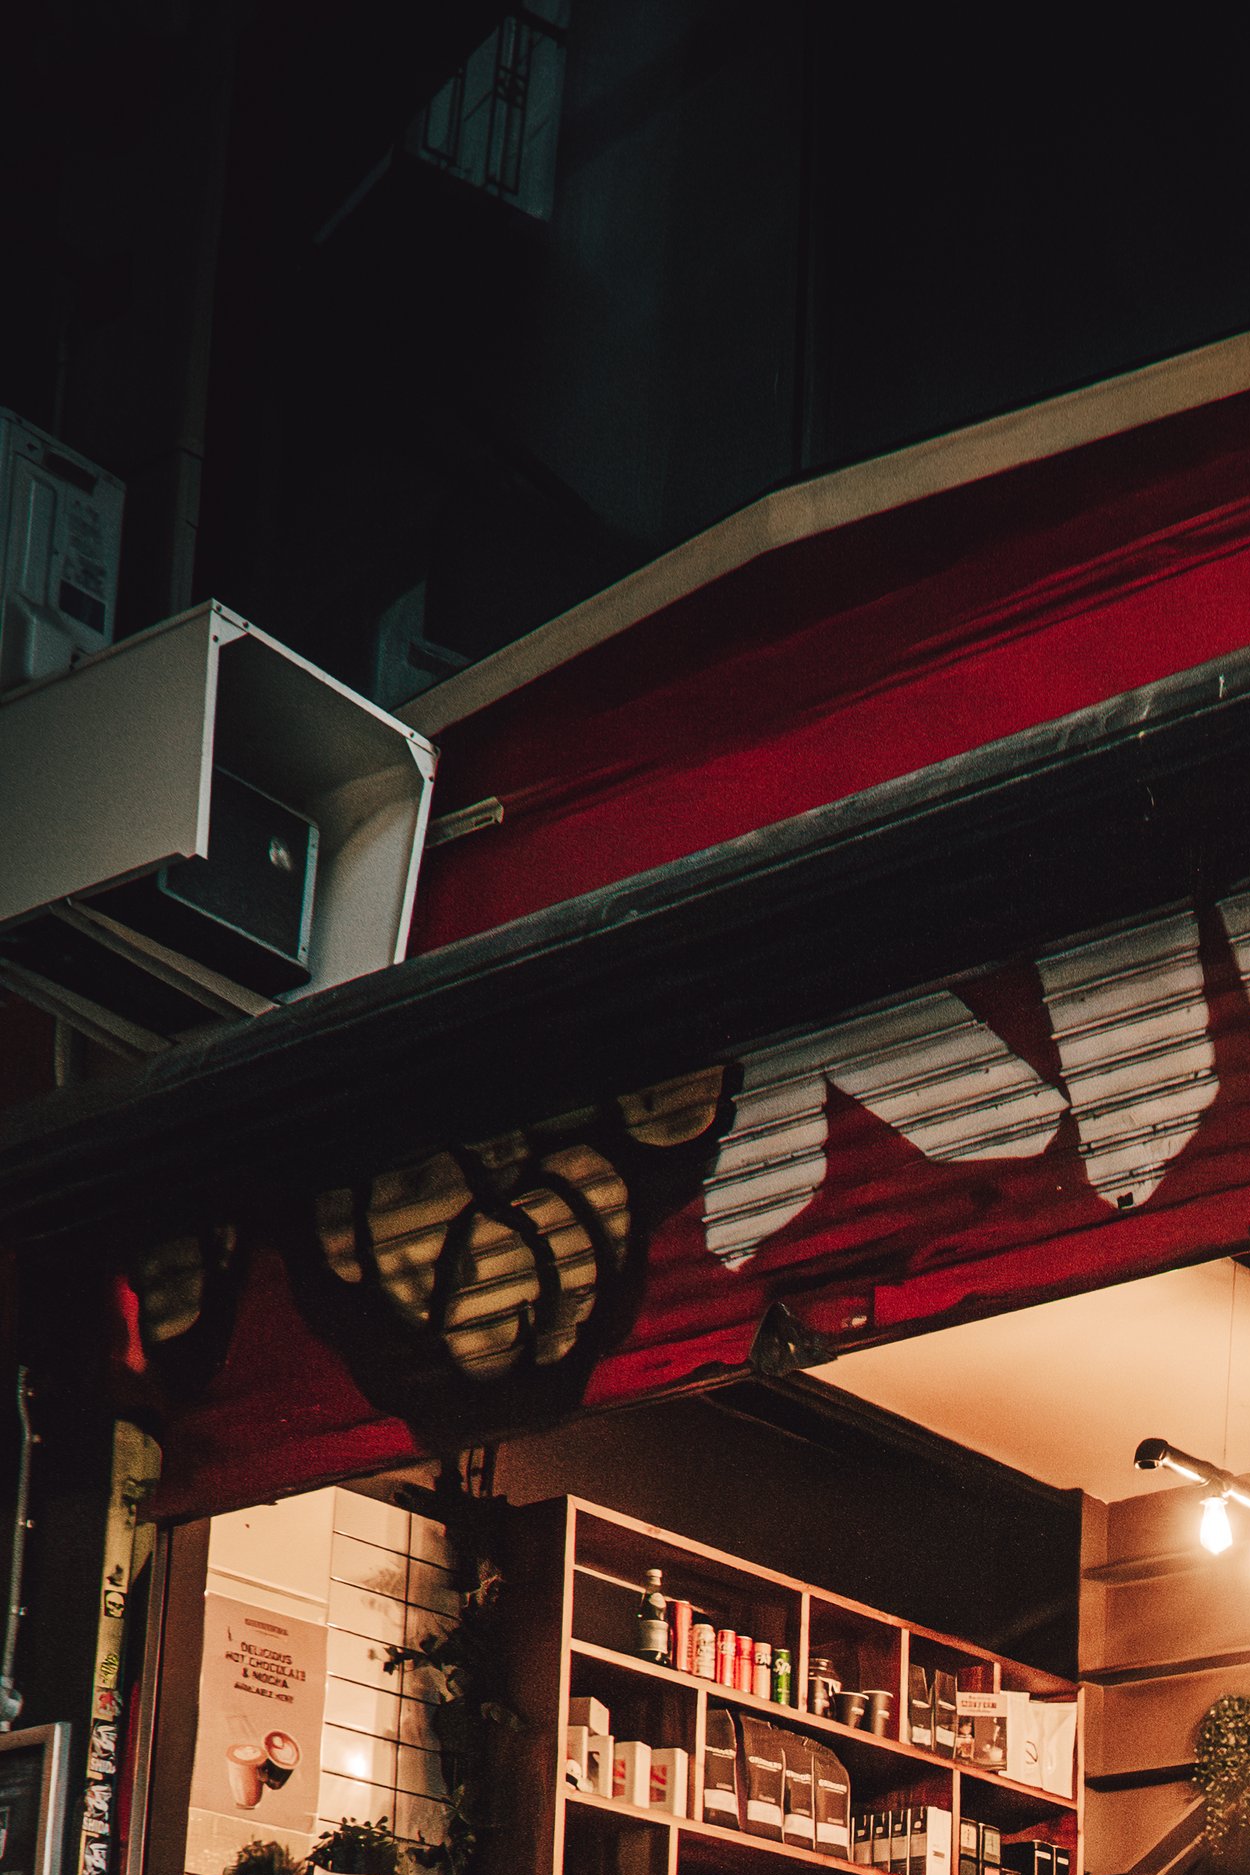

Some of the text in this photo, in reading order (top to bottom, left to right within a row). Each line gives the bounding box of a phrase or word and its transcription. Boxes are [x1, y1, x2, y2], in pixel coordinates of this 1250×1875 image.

[241, 1641, 293, 1665] DELICIOUS
[225, 1650, 306, 1681] HOT CHOCOLATE
[252, 1671, 289, 1689] MOCHA
